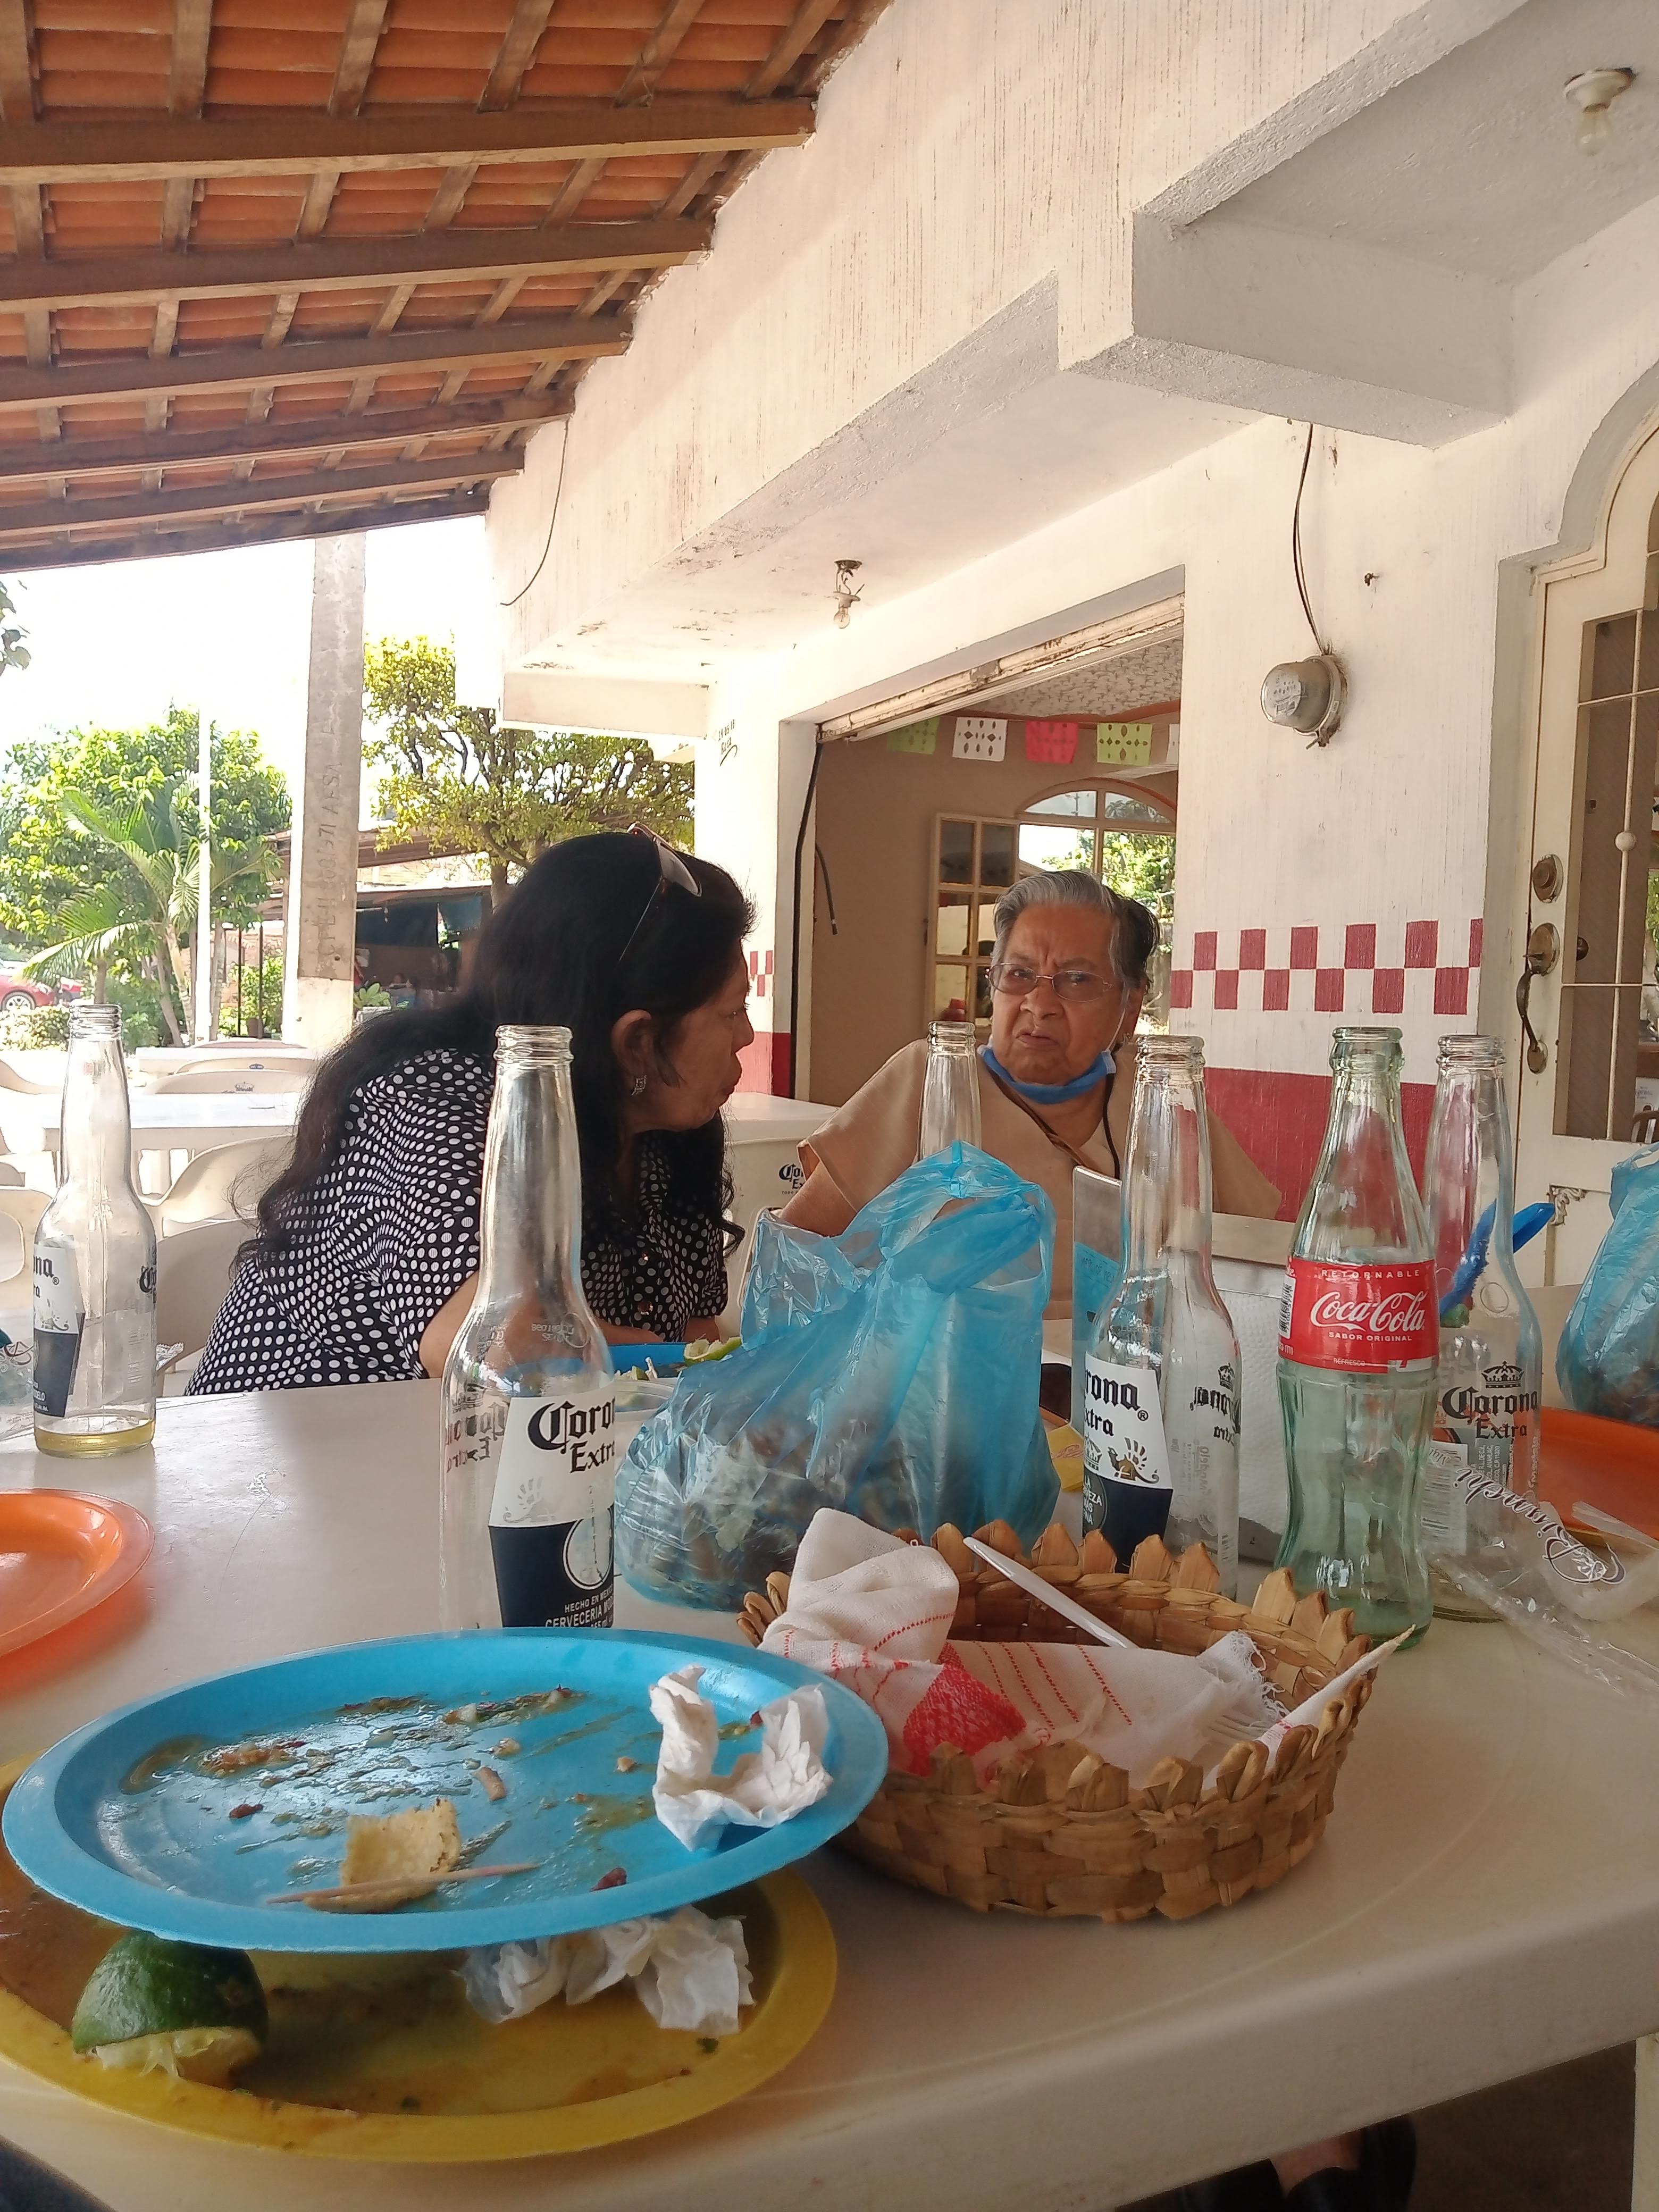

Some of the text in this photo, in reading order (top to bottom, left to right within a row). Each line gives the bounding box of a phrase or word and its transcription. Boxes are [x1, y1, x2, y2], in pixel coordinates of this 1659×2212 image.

[1321, 1269, 1420, 1278] RETORNABLE
[1310, 1291, 1427, 1333] Coca-Cola
[1329, 1331, 1363, 1340] SABOR
[1442, 1386, 1538, 1424] Corona
[1475, 1417, 1528, 1439] Extra
[565, 1598, 590, 1613] HECHO
[591, 1595, 599, 1605] EN
[545, 1605, 602, 1628] CERVECERIA
